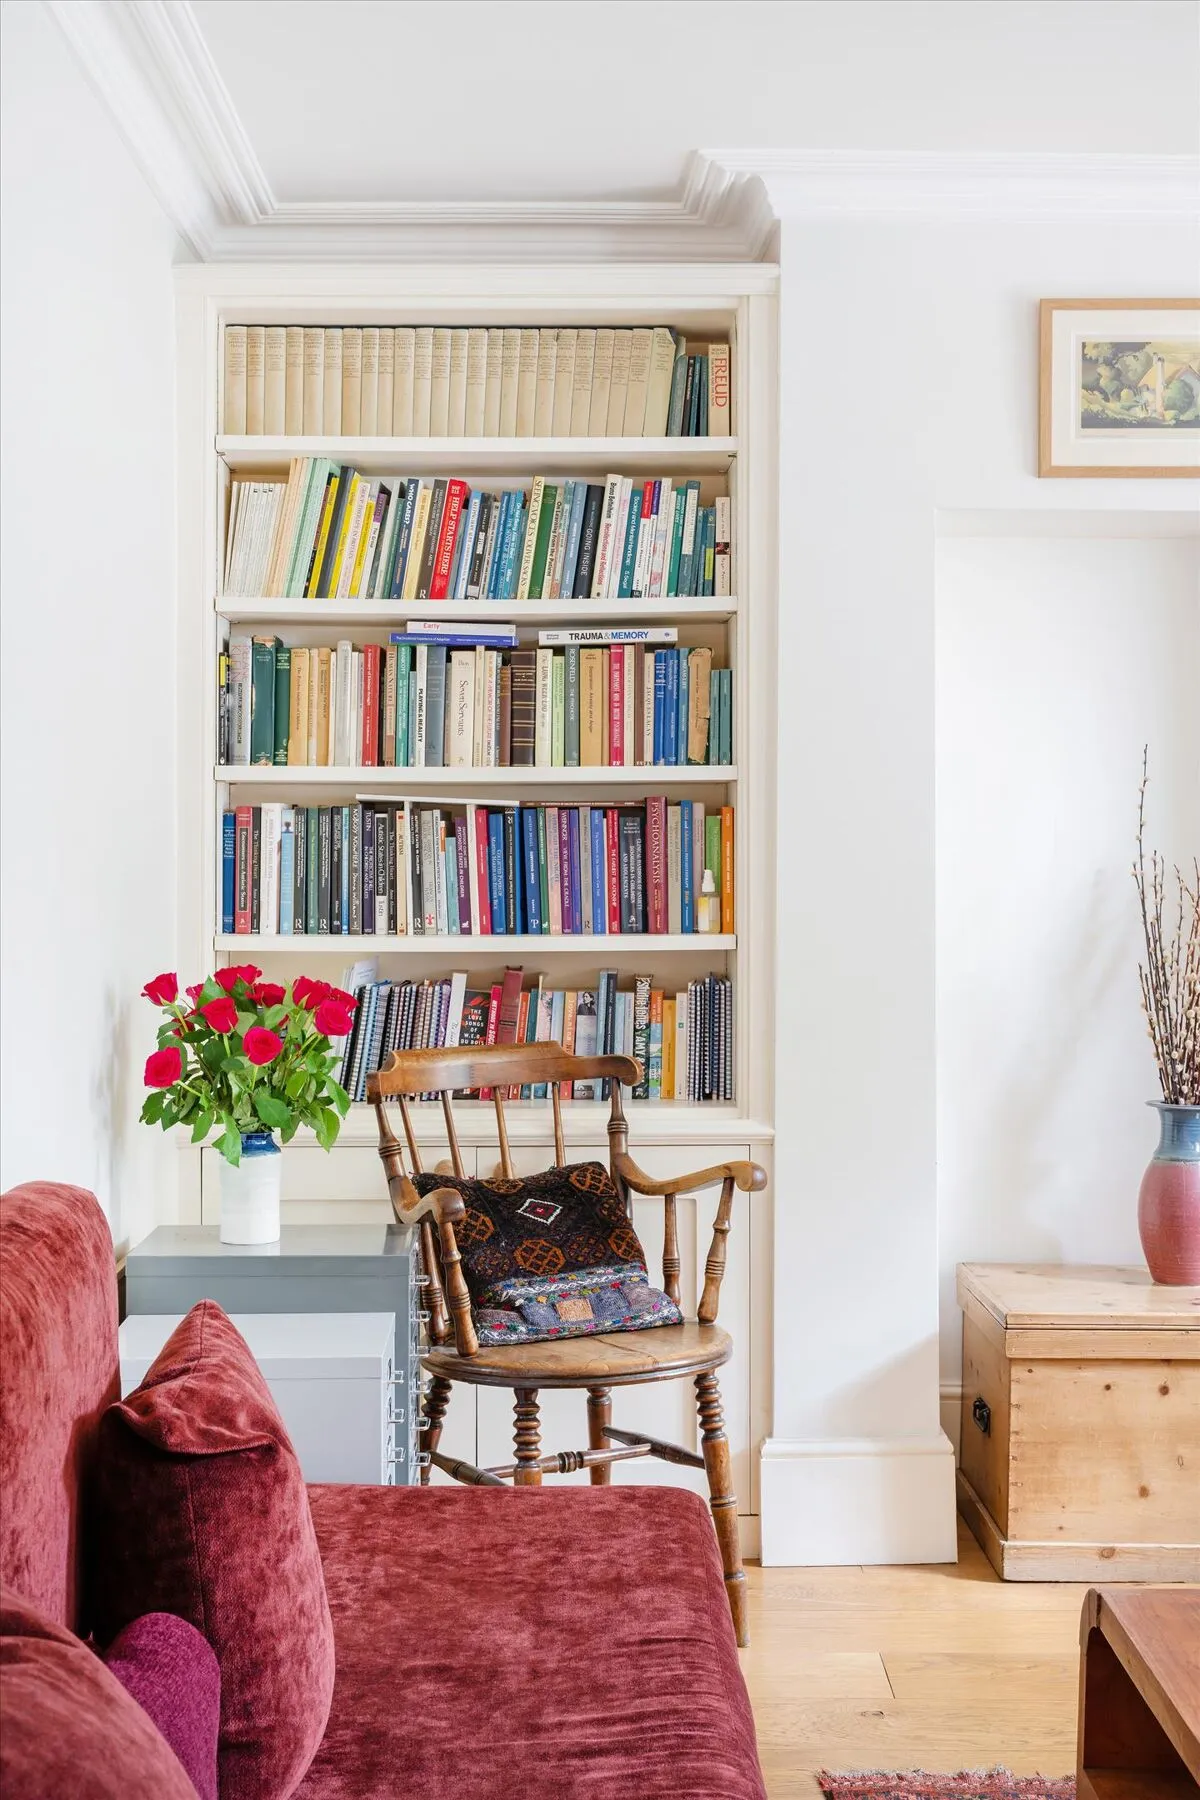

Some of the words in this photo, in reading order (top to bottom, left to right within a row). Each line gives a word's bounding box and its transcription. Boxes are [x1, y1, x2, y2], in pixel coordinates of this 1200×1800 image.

[714, 358, 728, 408] FREUD
[407, 484, 415, 500] WHO
[451, 497, 460, 520] HELP
[444, 520, 456, 551] STARTS
[584, 529, 593, 550] GOING
[440, 552, 450, 575] HERE
[580, 553, 590, 576] INSIDE
[378, 823, 386, 844] Autistic
[651, 802, 660, 883] PSYCHOANALYSIS
[378, 870, 386, 894] Children
